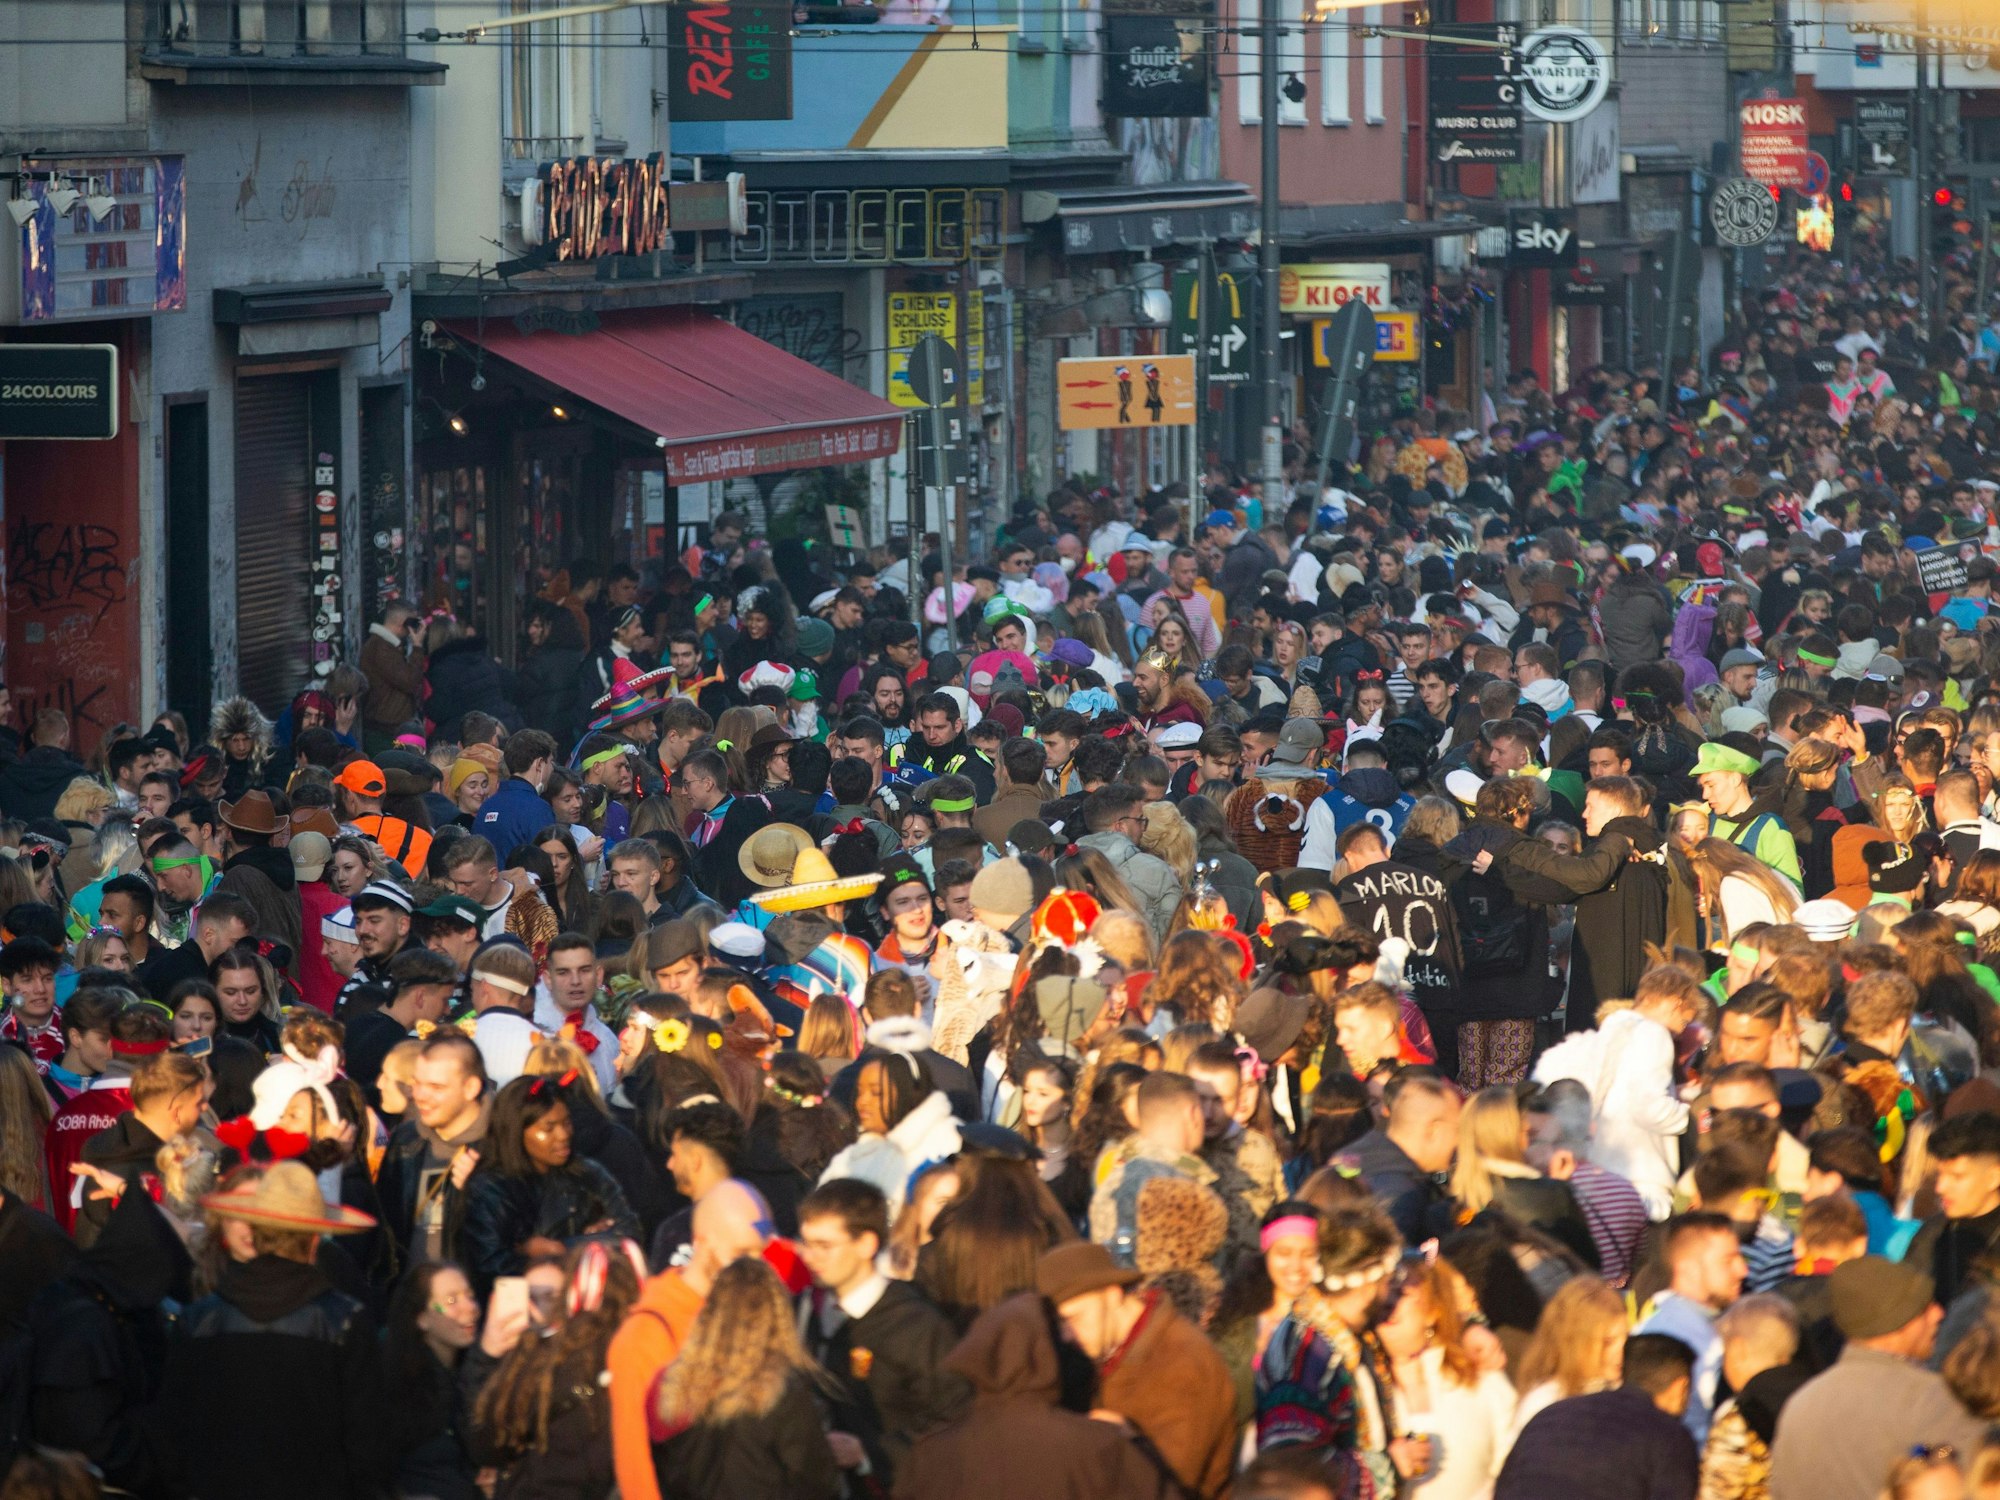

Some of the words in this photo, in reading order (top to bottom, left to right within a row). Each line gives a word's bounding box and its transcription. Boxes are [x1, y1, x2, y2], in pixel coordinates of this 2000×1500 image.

[1129, 46, 1184, 67] Gaffel
[1436, 116, 1479, 129] MUSIC
[1480, 116, 1517, 129] CLUB
[1741, 104, 1805, 125] KIOSK
[1516, 221, 1570, 254] sky
[2, 385, 98, 399] 24COLOURS
[1372, 900, 1439, 957] 10
